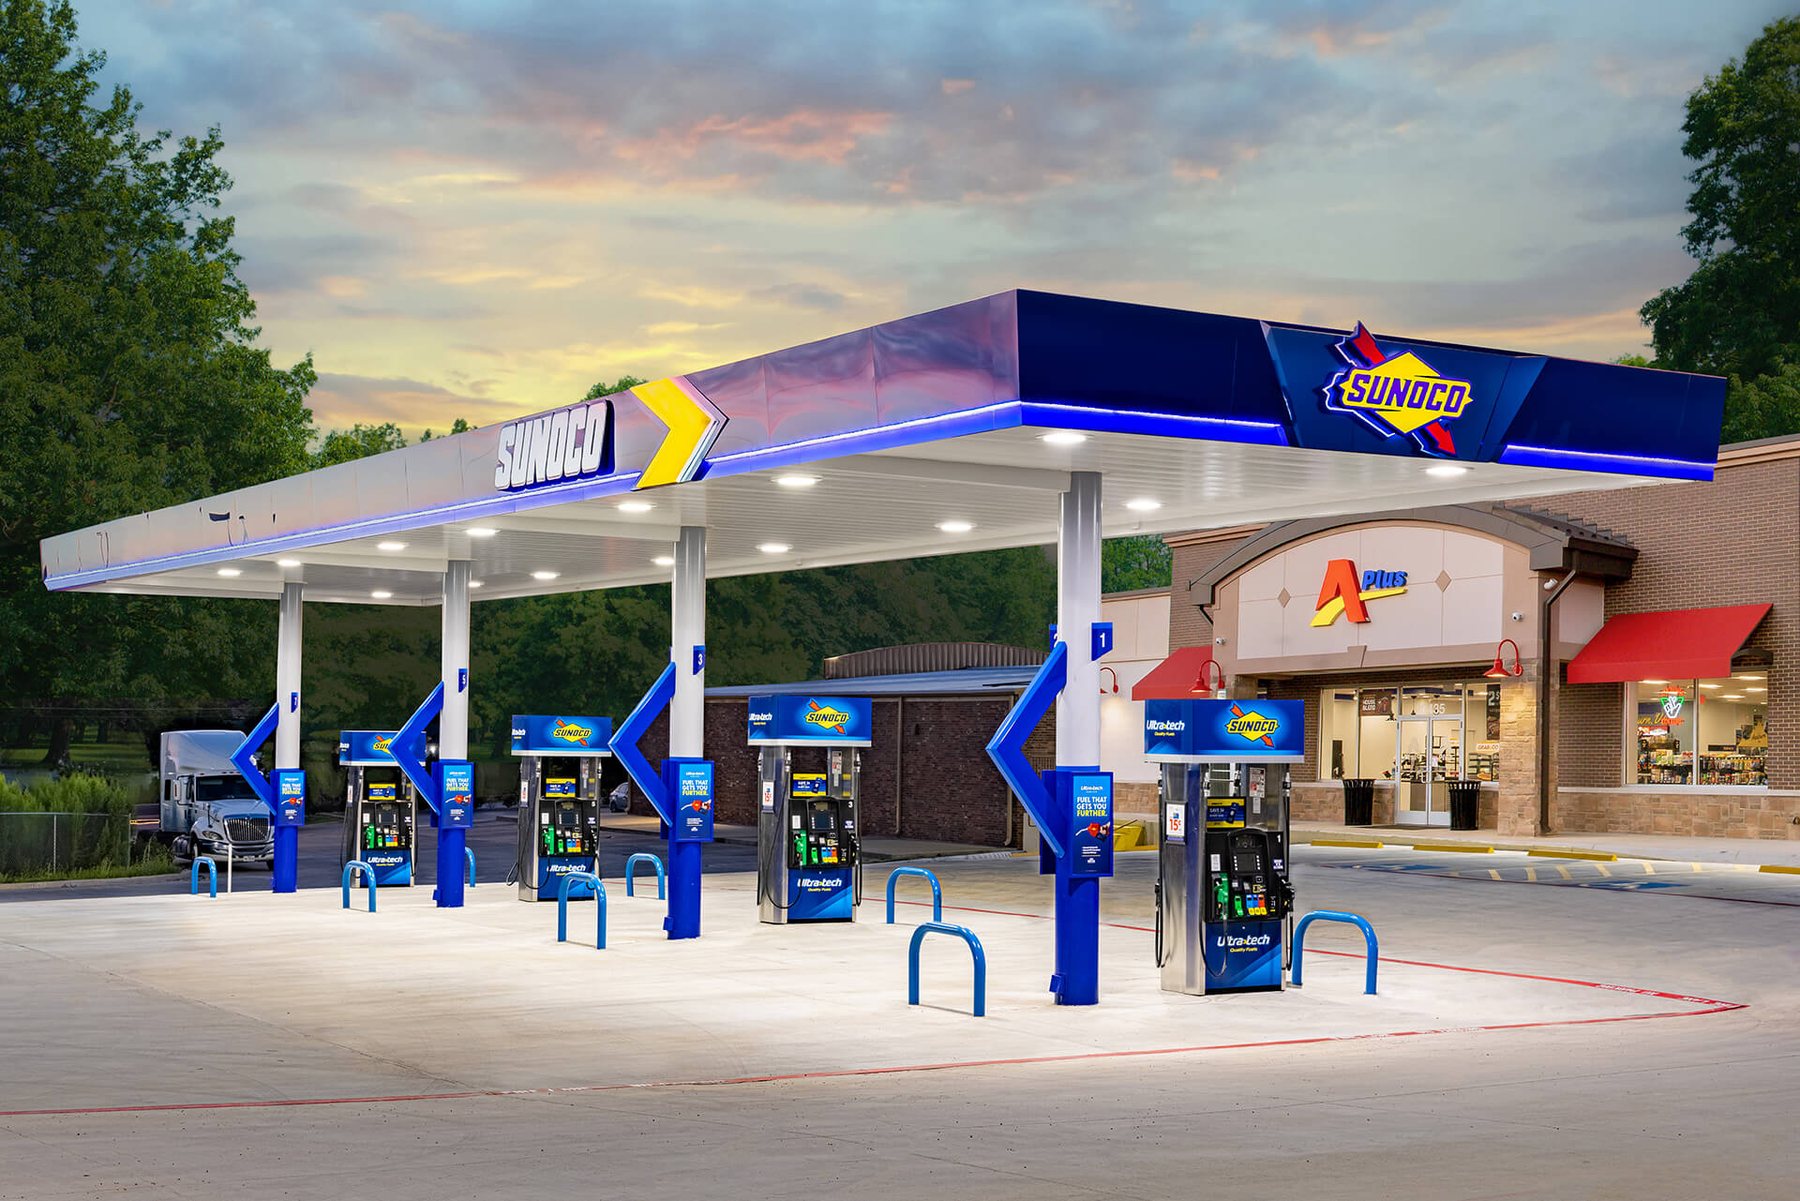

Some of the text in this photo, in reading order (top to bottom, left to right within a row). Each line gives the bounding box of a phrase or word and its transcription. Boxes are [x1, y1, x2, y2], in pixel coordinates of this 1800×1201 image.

[1346, 373, 1467, 413] SUNOCO
[494, 401, 608, 490] SUNOCO
[1311, 559, 1408, 627] A Plus
[1099, 632, 1106, 648] 1
[697, 653, 703, 666] 3
[807, 712, 848, 723] SUNOCO
[1228, 720, 1276, 732] SUNOCO
[555, 729, 590, 737] SUNOCO
[1277, 834, 1281, 843] 1
